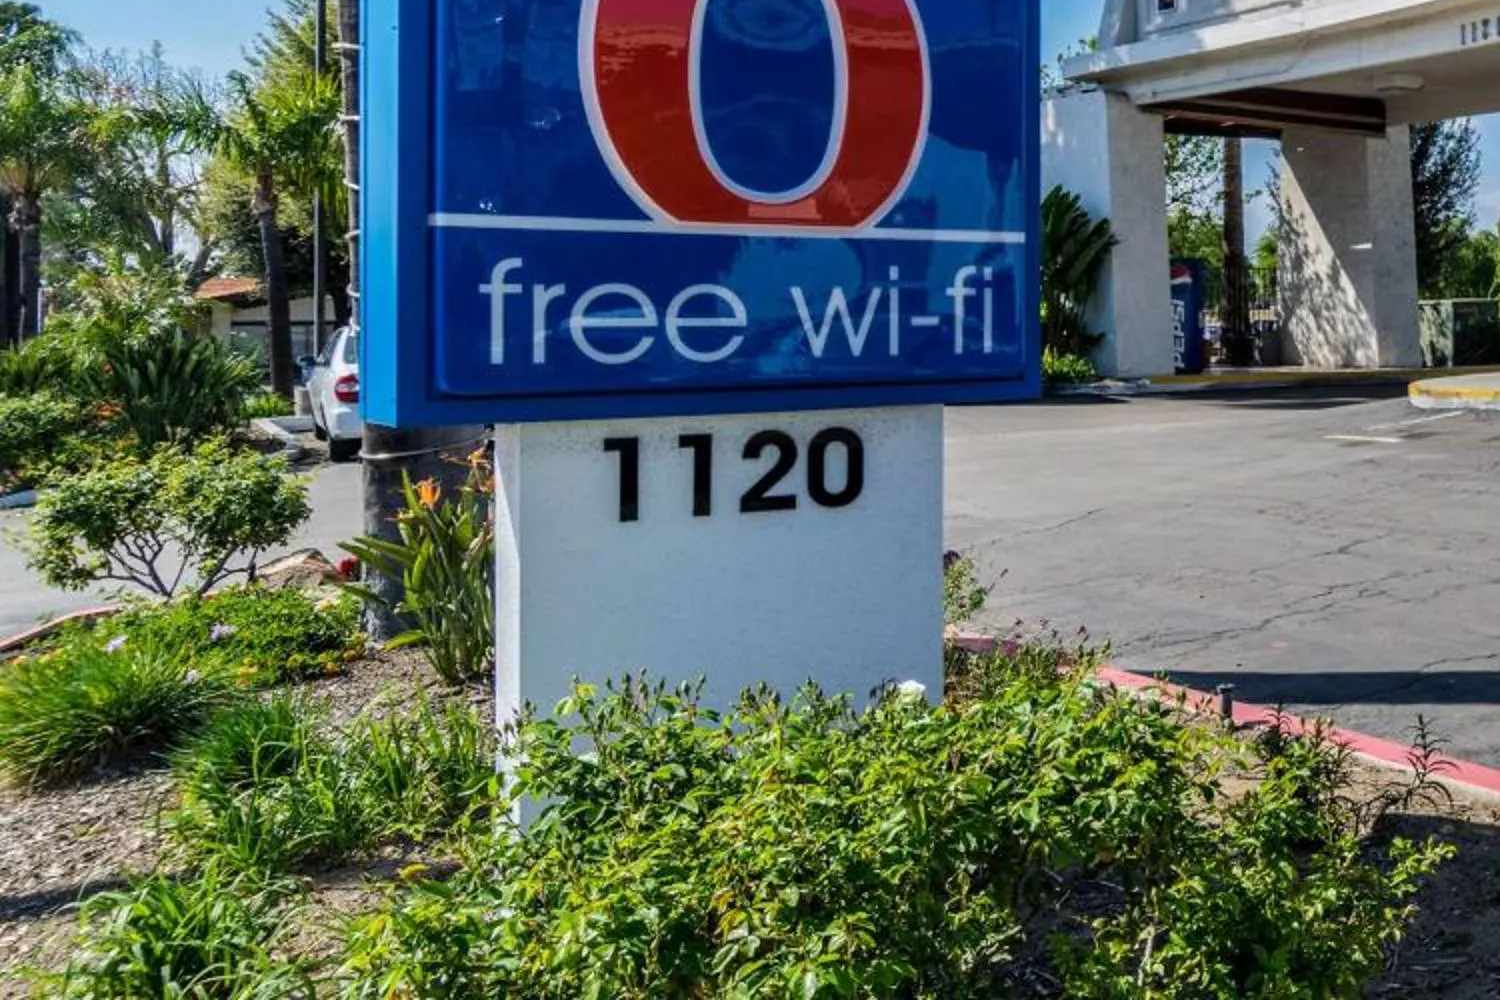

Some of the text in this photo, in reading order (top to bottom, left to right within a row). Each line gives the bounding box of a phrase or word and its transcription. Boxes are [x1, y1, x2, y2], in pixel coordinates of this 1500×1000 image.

[478, 256, 993, 365] free wi-fi
[603, 425, 865, 523] 1120
